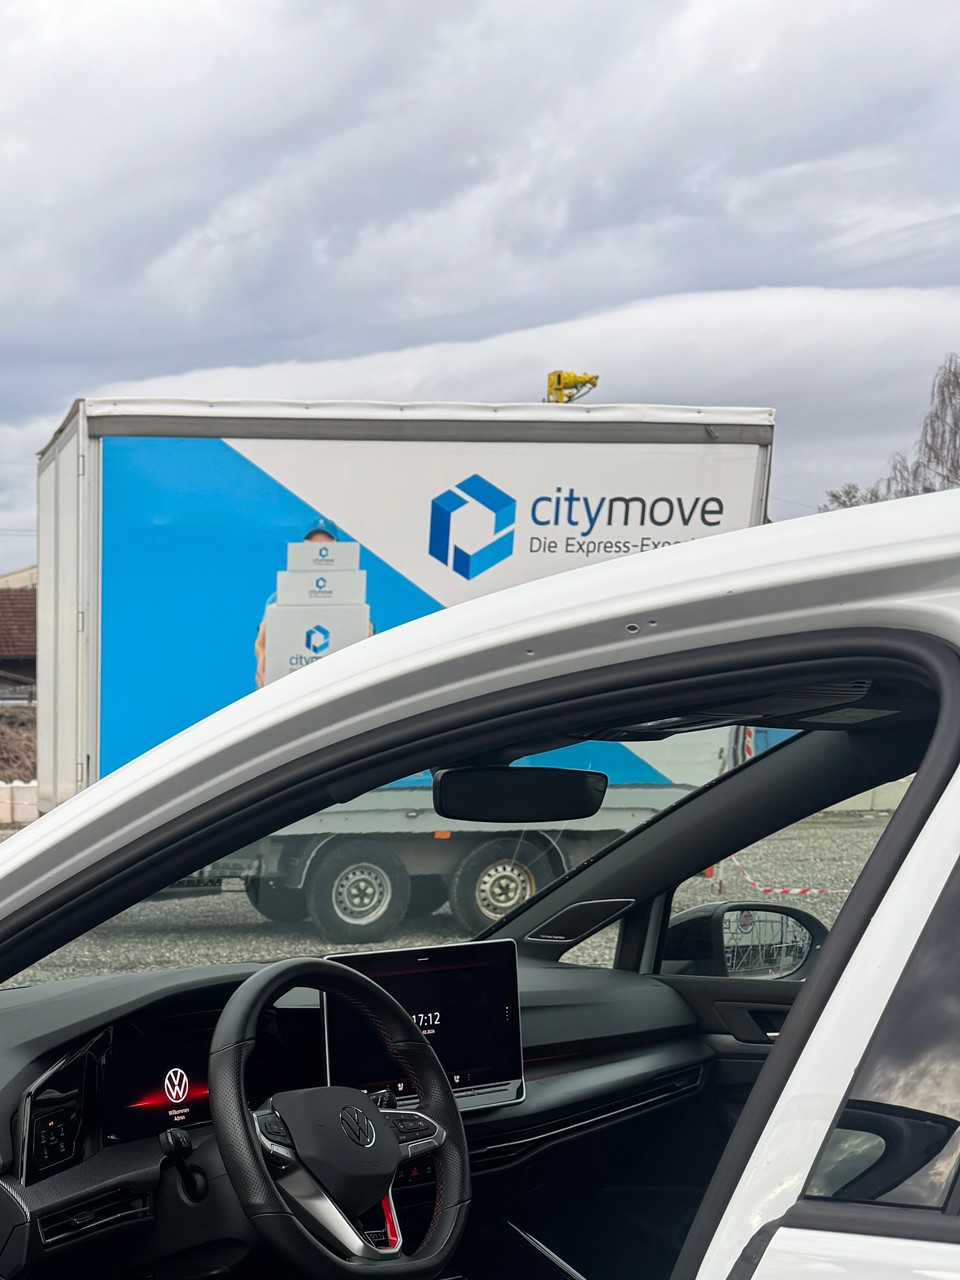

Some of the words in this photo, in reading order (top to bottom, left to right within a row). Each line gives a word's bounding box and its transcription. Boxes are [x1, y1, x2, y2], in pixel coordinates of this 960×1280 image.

[530, 486, 725, 537] citymove
[529, 537, 558, 553] Die
[412, 1012, 441, 1026] 17:12
